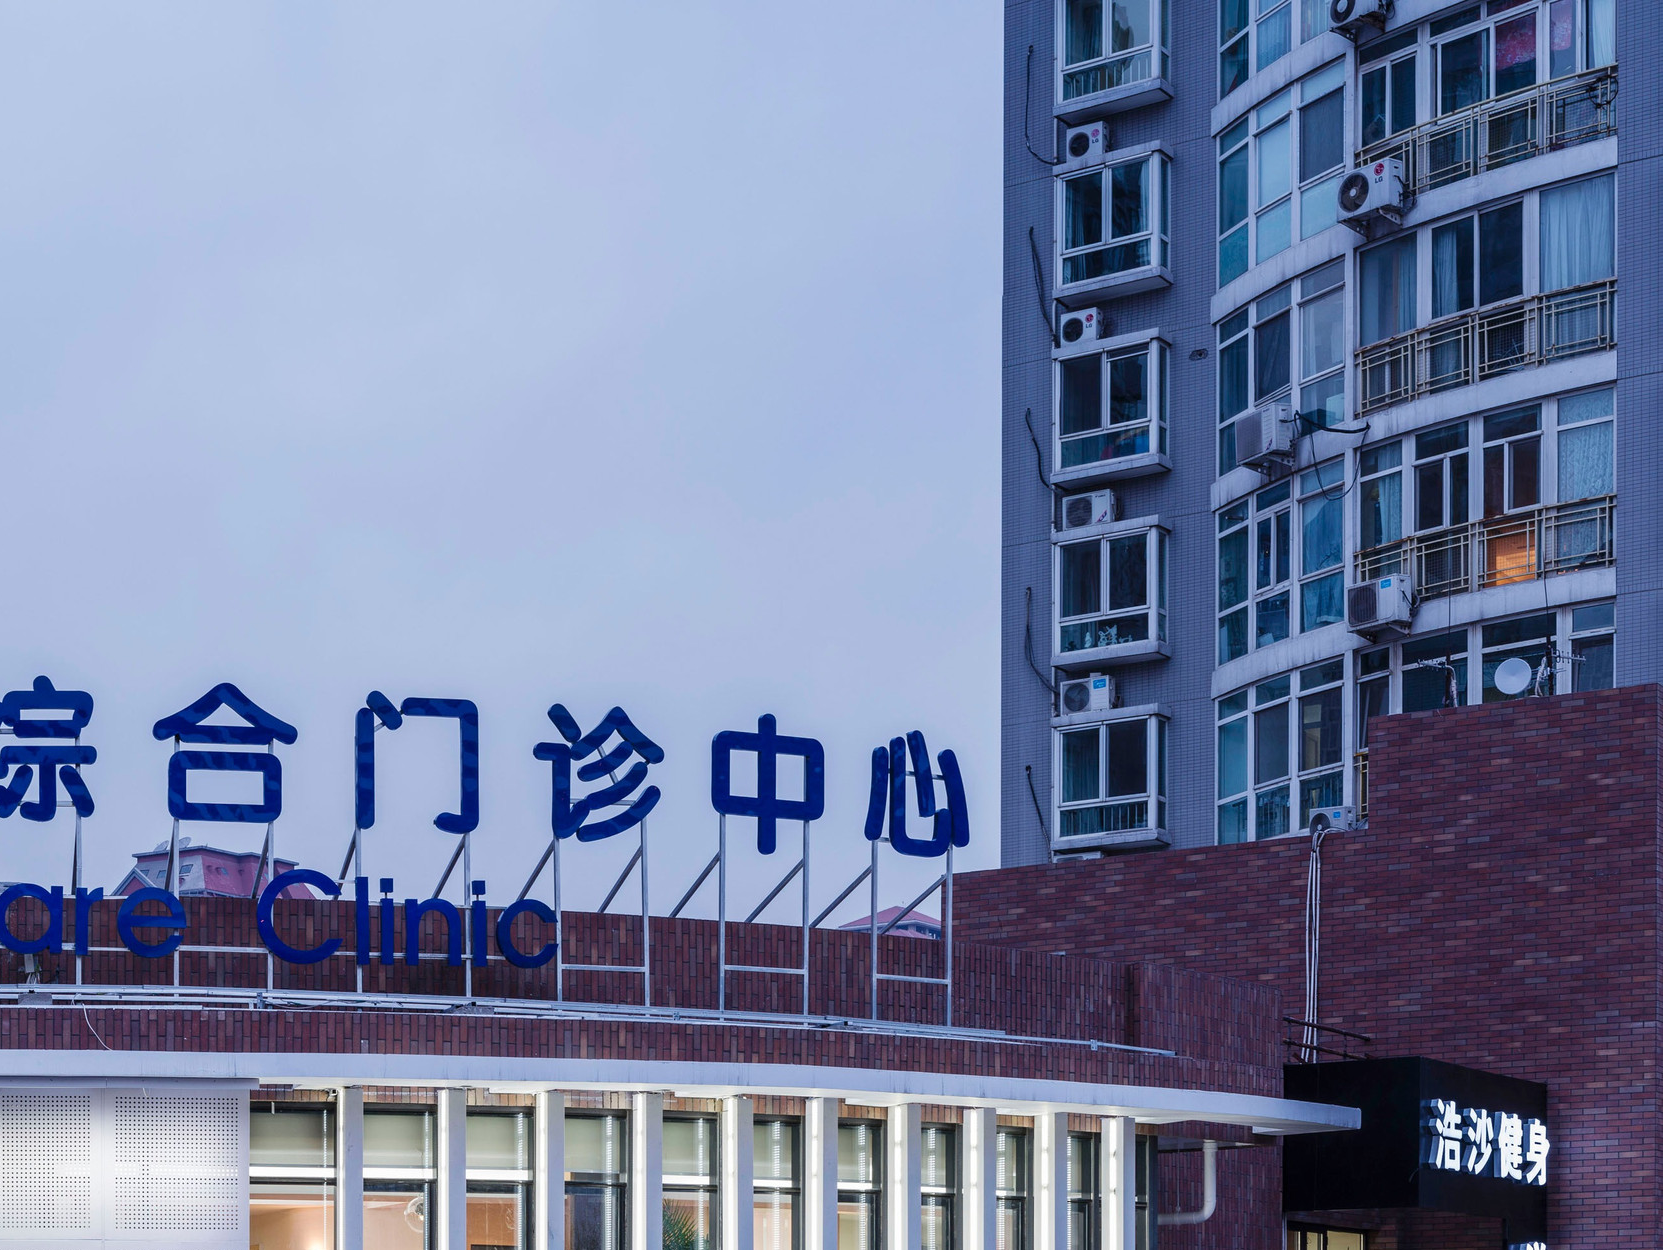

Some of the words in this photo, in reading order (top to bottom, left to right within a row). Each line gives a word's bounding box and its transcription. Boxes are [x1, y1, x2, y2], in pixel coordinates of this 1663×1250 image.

[255, 869, 559, 970] Clinic
[1435, 1098, 1551, 1186] 浩沙健身
